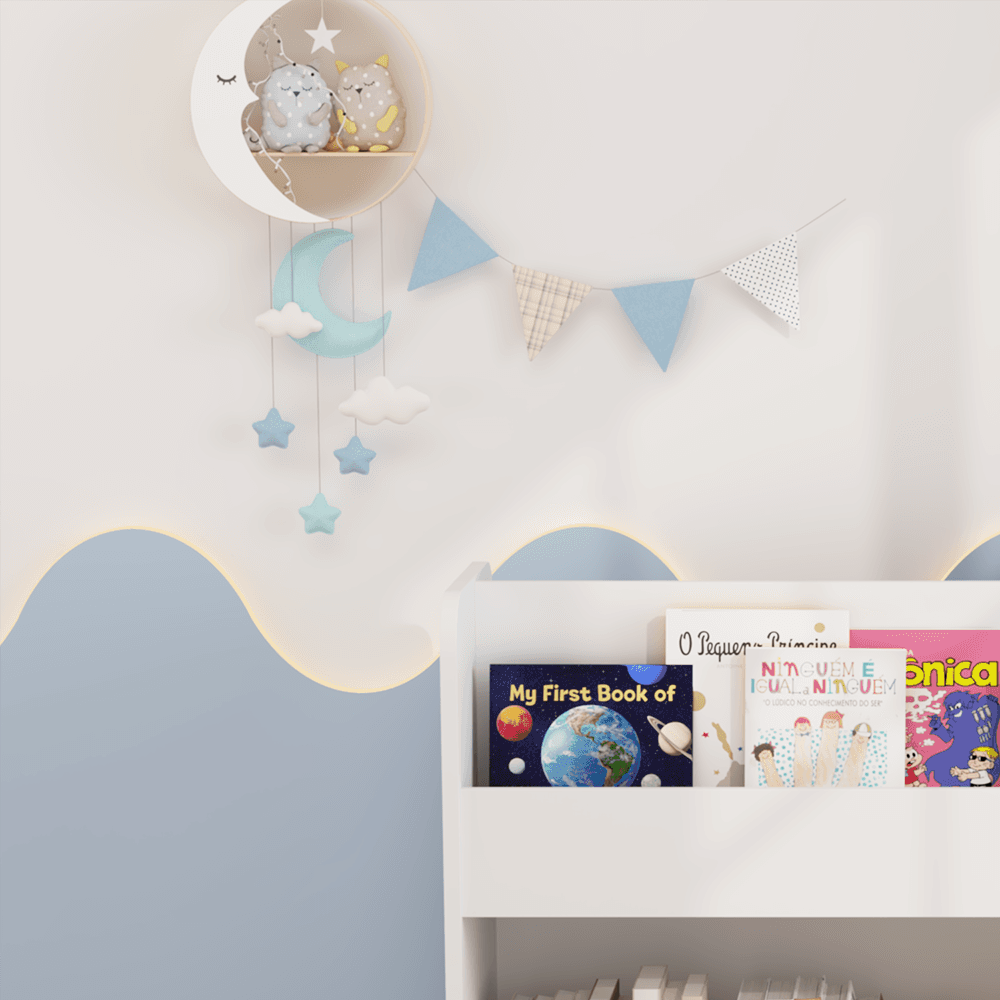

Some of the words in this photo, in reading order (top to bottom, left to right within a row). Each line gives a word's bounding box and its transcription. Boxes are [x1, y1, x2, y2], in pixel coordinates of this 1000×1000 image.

[679, 631, 692, 656] O
[697, 631, 763, 662] Pequen
[862, 659, 874, 677] É
[906, 657, 999, 687] ônica
[509, 684, 537, 706] My
[543, 684, 592, 702] First
[597, 684, 648, 702] Book
[654, 684, 677, 702] of
[751, 678, 801, 695] IGUAL
[772, 698, 796, 707] LÚDICO
[809, 699, 857, 707] CONHECIMENTO
[859, 699, 869, 707] DO
